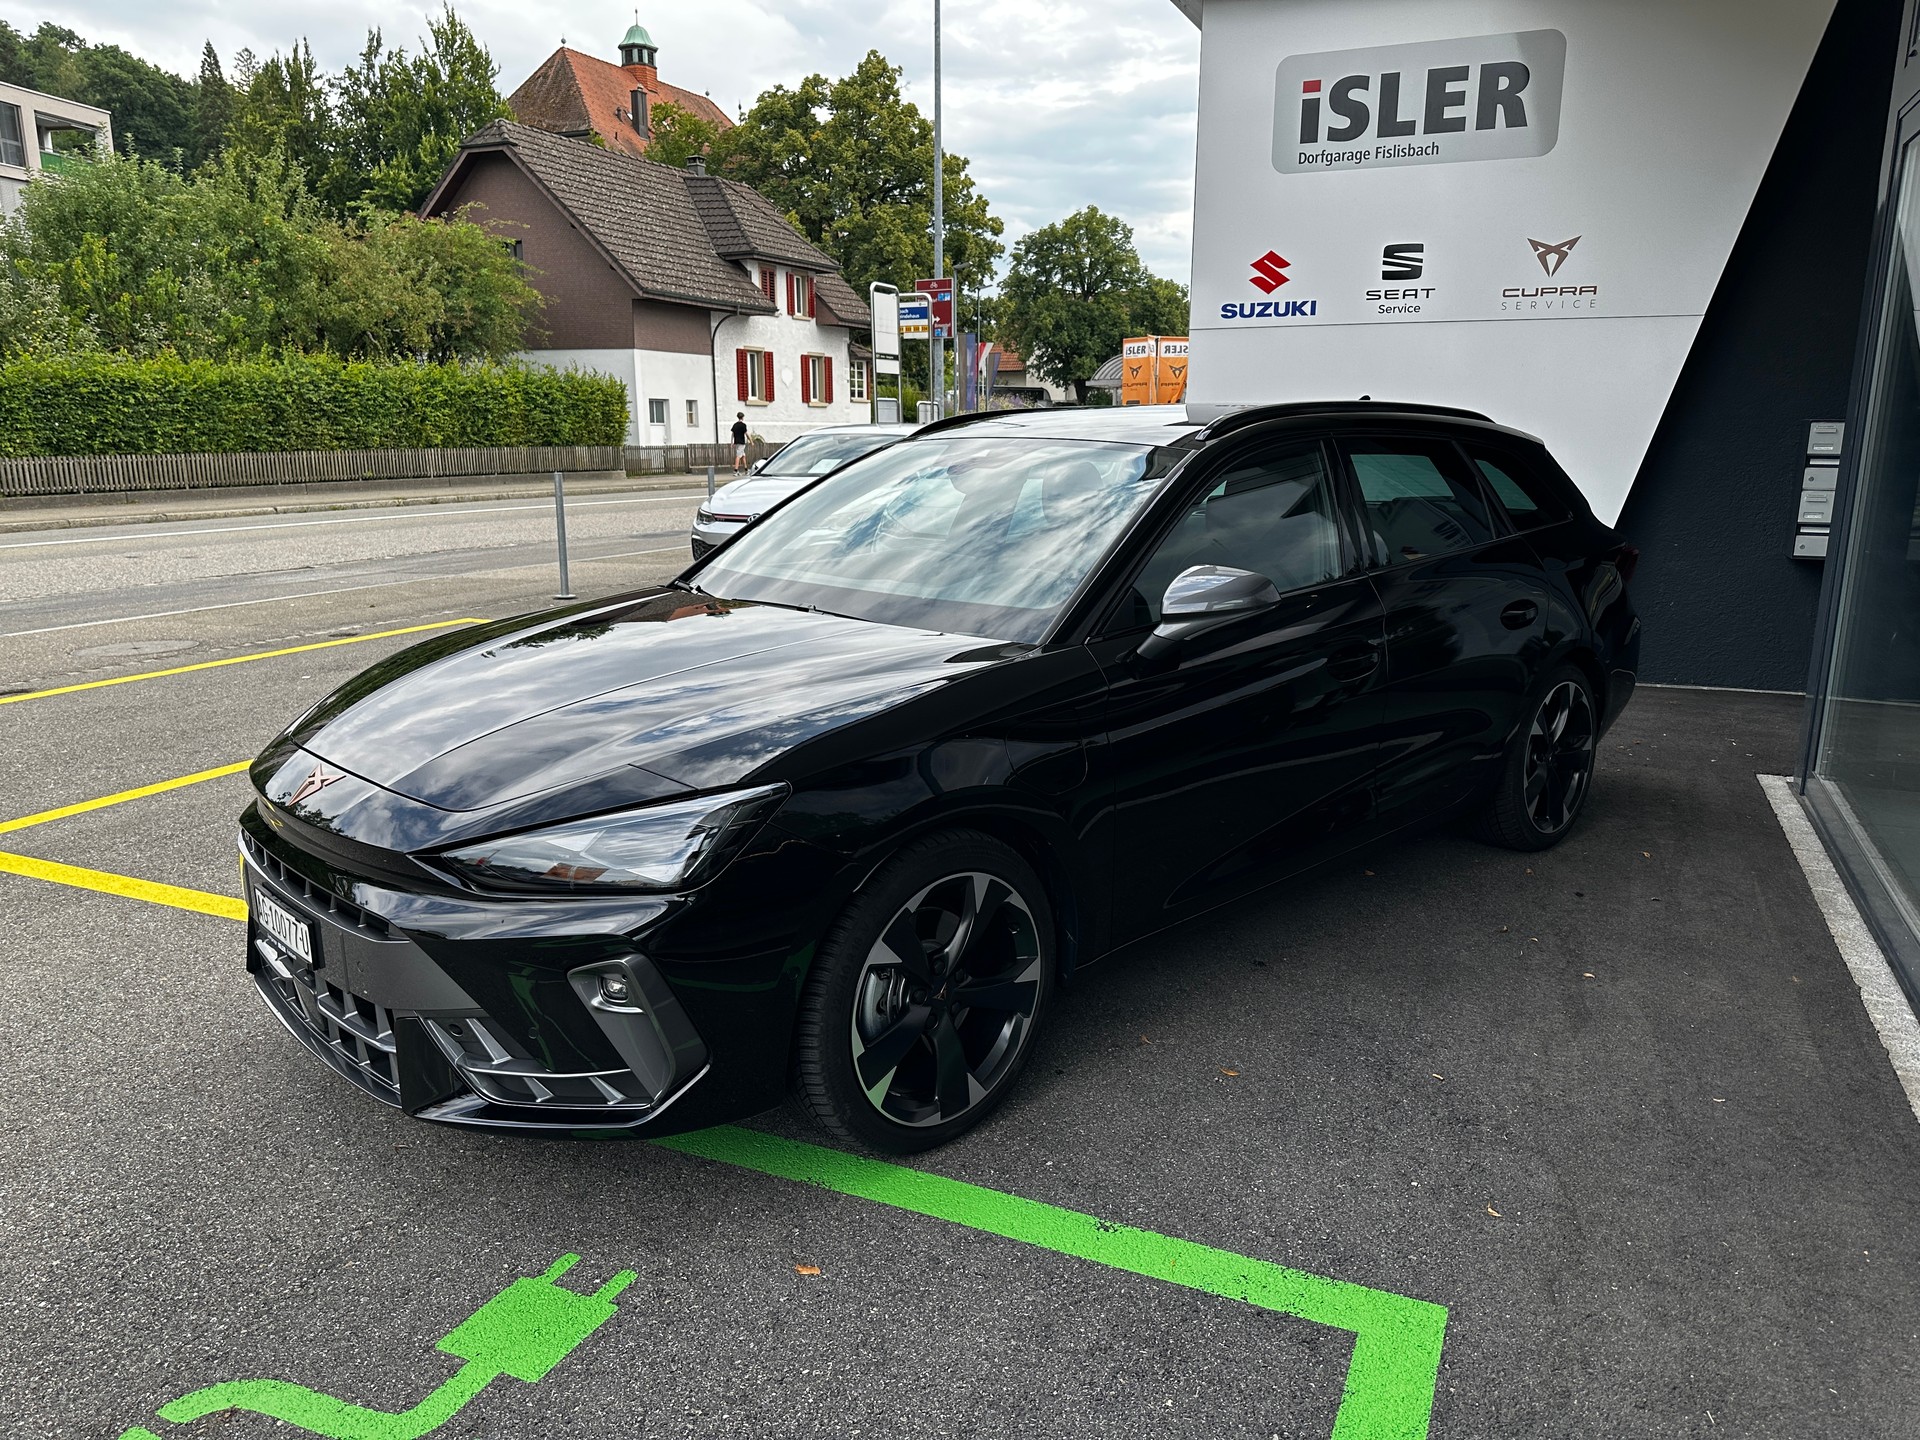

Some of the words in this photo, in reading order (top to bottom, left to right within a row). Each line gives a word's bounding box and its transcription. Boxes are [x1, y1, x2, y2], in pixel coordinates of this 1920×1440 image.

[1300, 61, 1530, 144] iSLER
[1298, 150, 1370, 166] Dorfgarage
[1375, 142, 1439, 160] Fislisbach
[1365, 288, 1436, 301] SEAT
[1502, 285, 1597, 298] CUPRA
[1220, 300, 1317, 319] SUZUKI
[1377, 303, 1421, 314] Service
[1501, 299, 1597, 311] SERVICE
